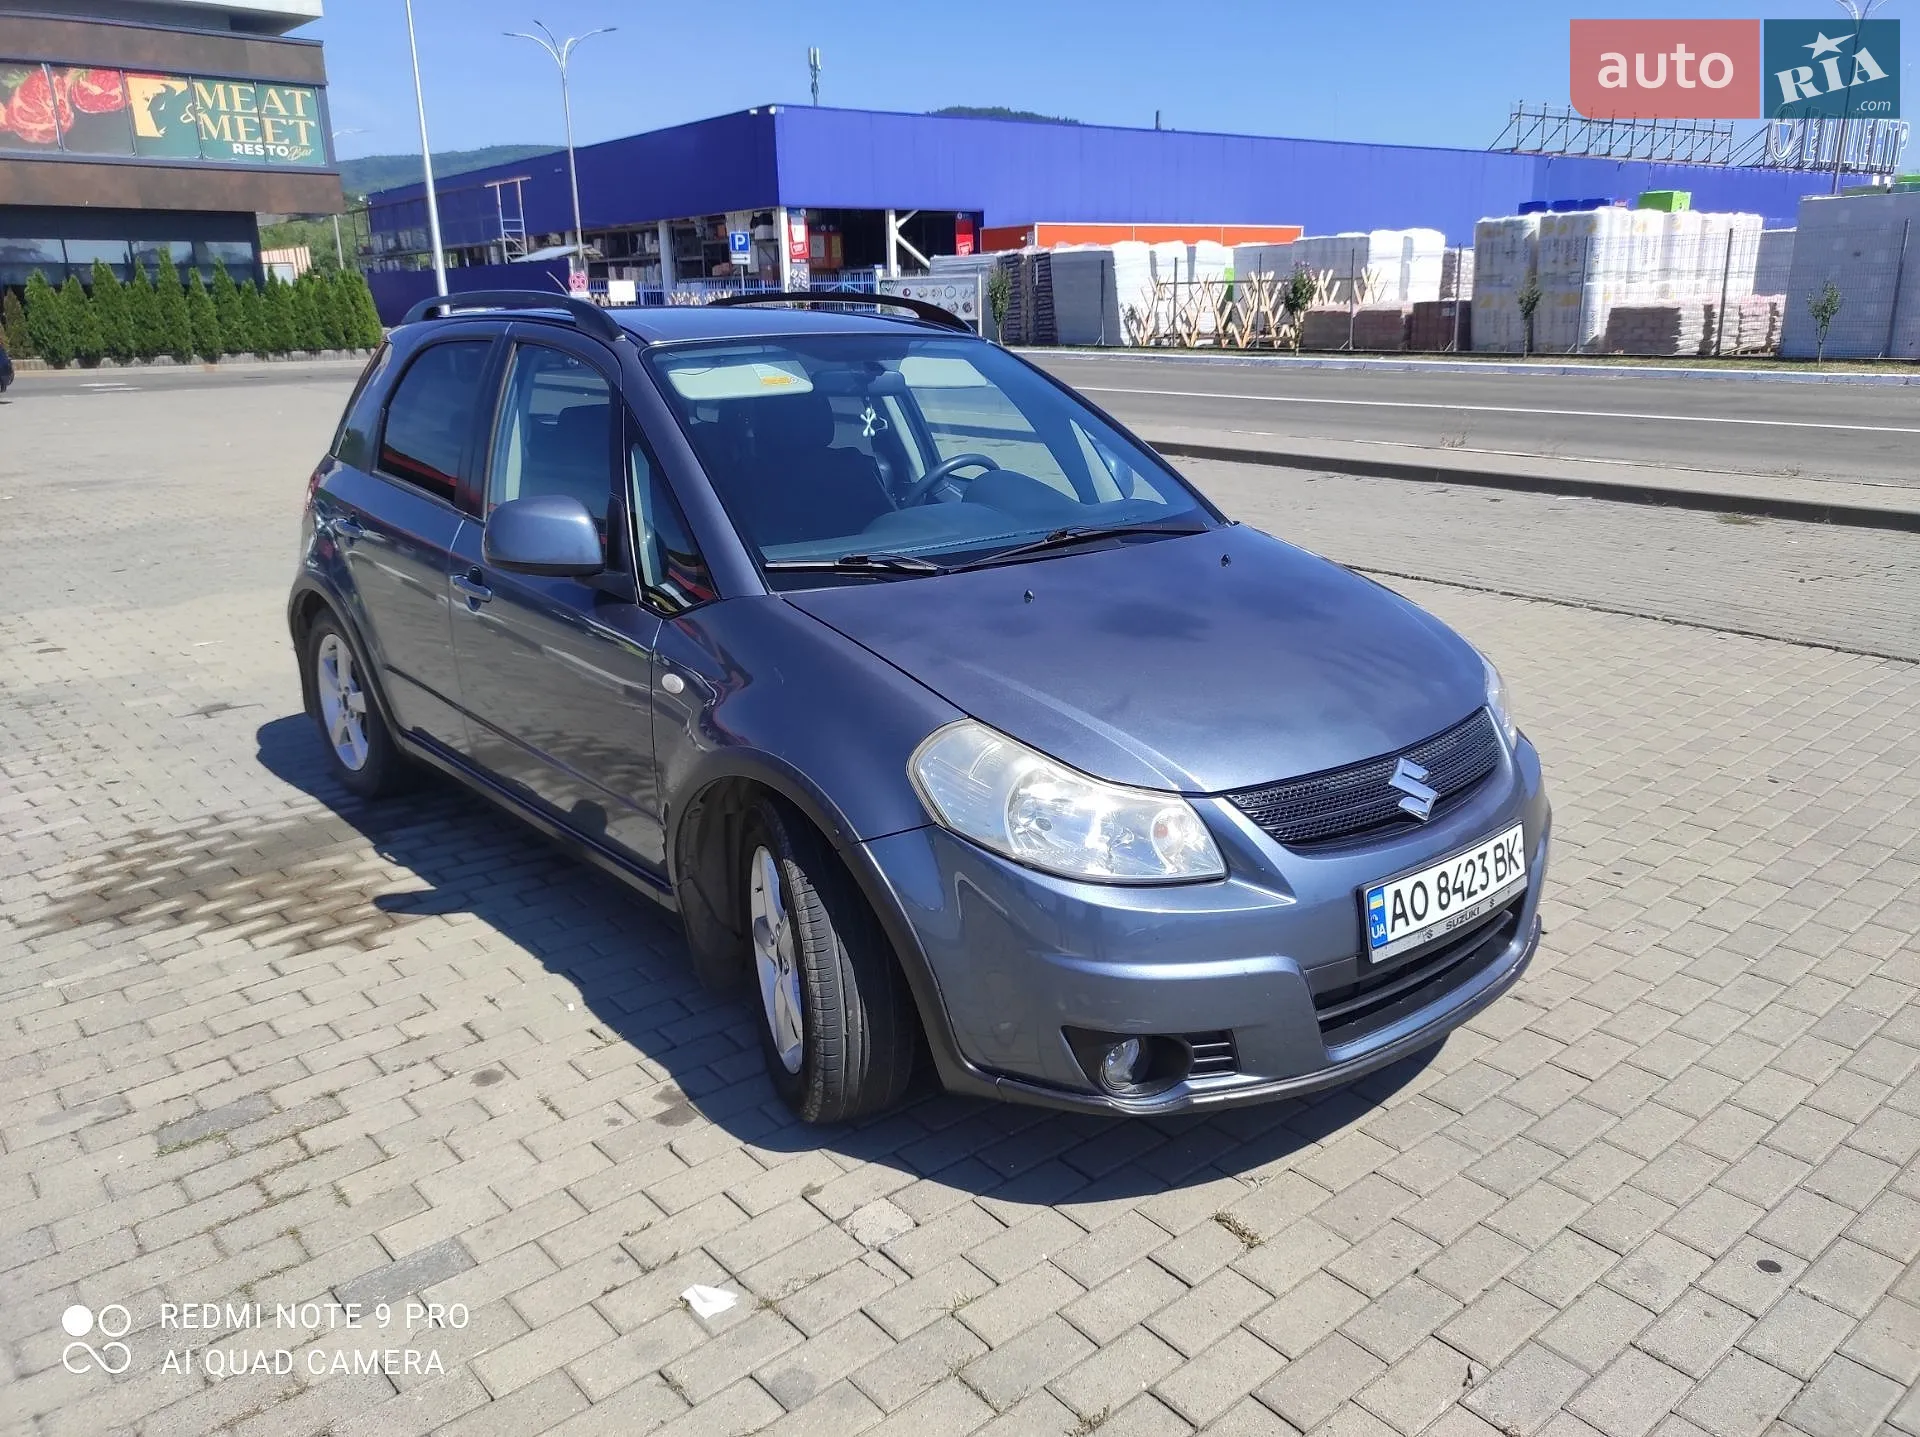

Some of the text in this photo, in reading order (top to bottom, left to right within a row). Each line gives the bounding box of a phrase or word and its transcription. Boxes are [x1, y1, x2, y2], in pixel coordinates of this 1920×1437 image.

[193, 82, 311, 117] MEAT
[198, 113, 316, 146] MEET
[1803, 106, 1911, 170] ЕПЦЕНТР
[232, 143, 289, 157] RESTO
[1391, 833, 1520, 934] AO 8423 BK
[1372, 923, 1387, 939] UA
[1445, 906, 1480, 931] SUZUKI
